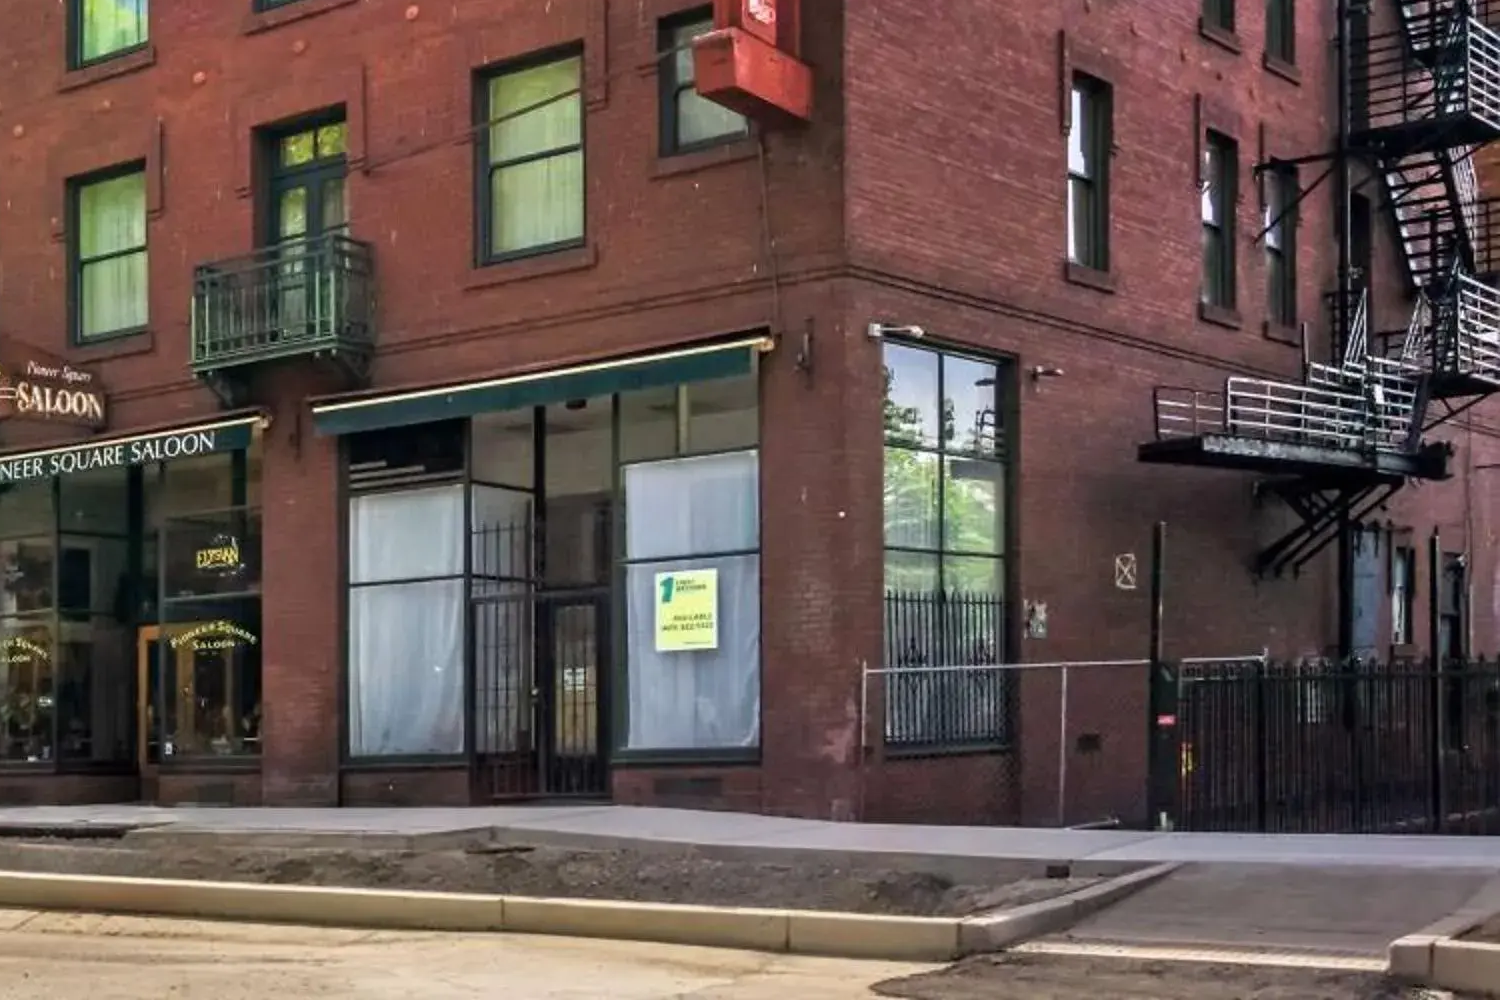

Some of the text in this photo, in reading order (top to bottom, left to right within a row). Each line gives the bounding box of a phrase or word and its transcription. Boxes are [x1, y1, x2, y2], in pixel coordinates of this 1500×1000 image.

[17, 381, 103, 418] SALOON
[50, 444, 124, 475] SQUARE
[131, 431, 216, 463] SALOON
